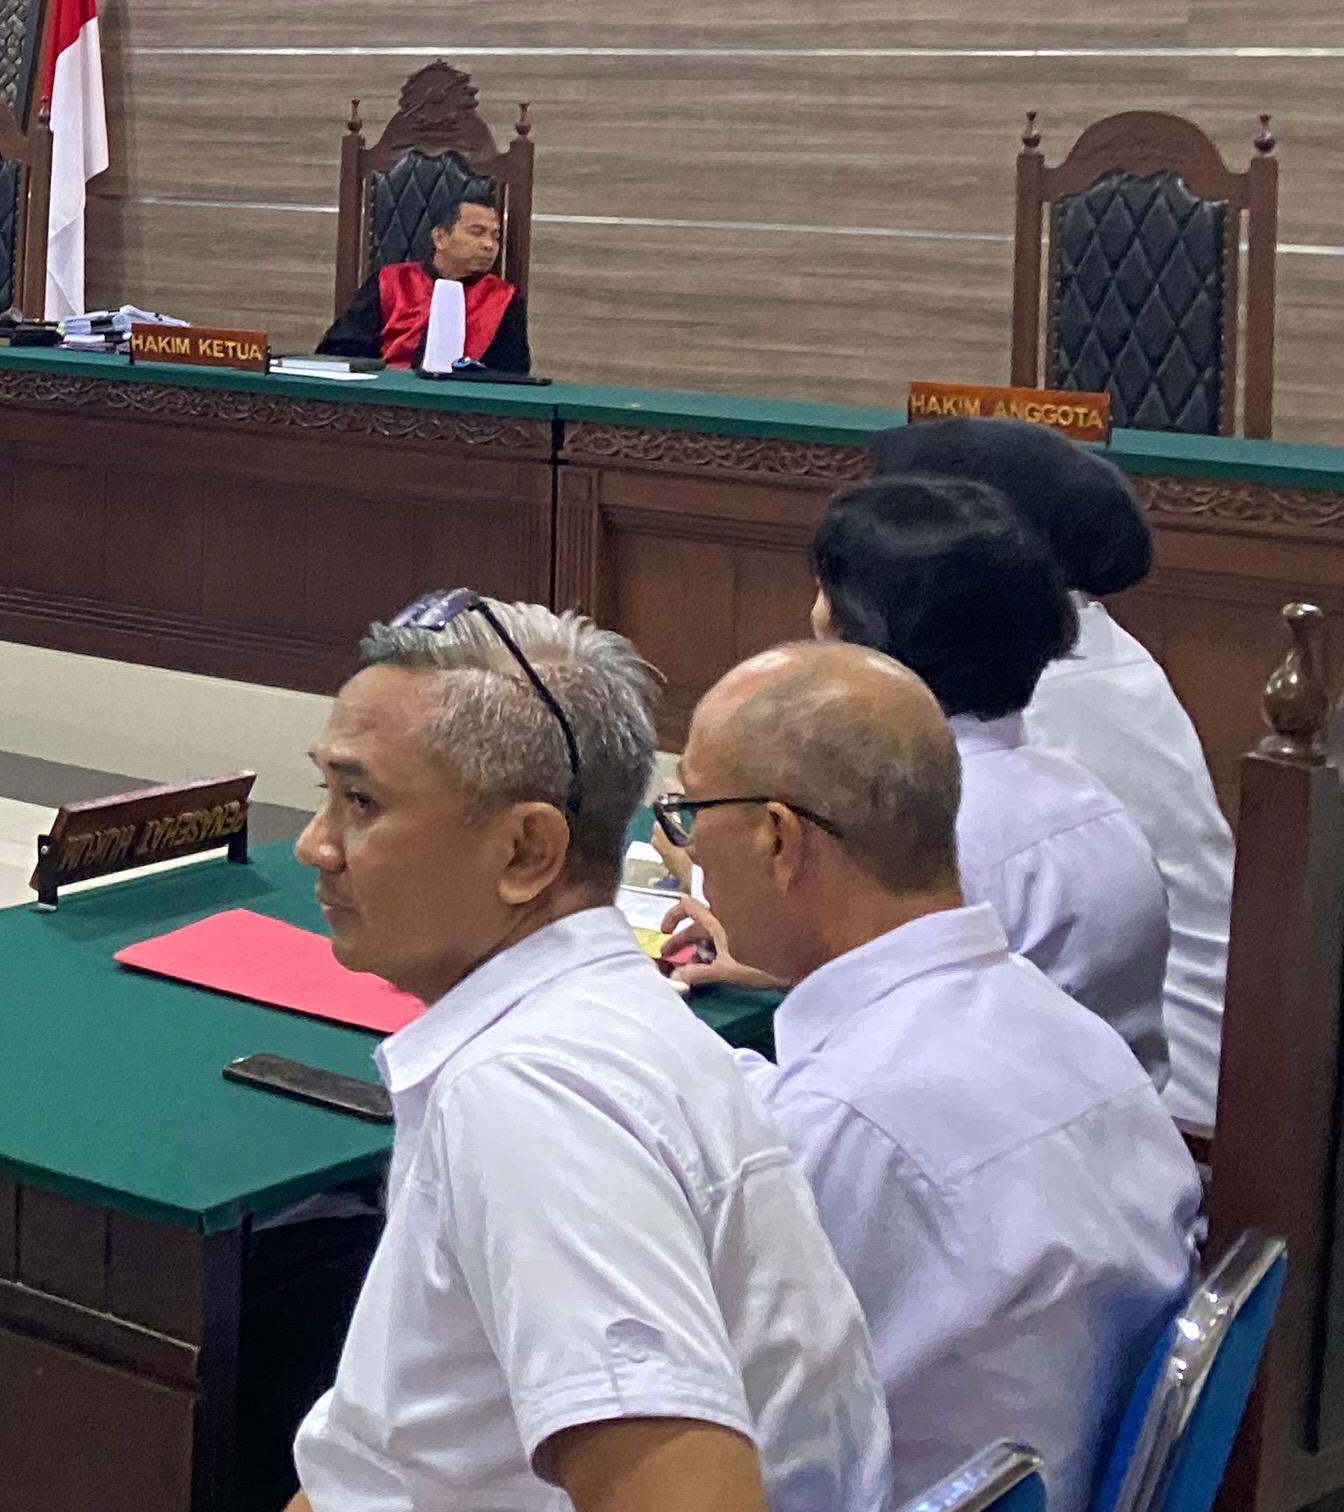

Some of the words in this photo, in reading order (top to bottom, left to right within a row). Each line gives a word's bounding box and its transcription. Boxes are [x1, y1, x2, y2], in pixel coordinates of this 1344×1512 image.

[131, 334, 191, 355] HAKIM
[199, 338, 263, 361] KETUA
[911, 392, 981, 418] HAKIM
[993, 400, 1104, 429] ANGGOTA
